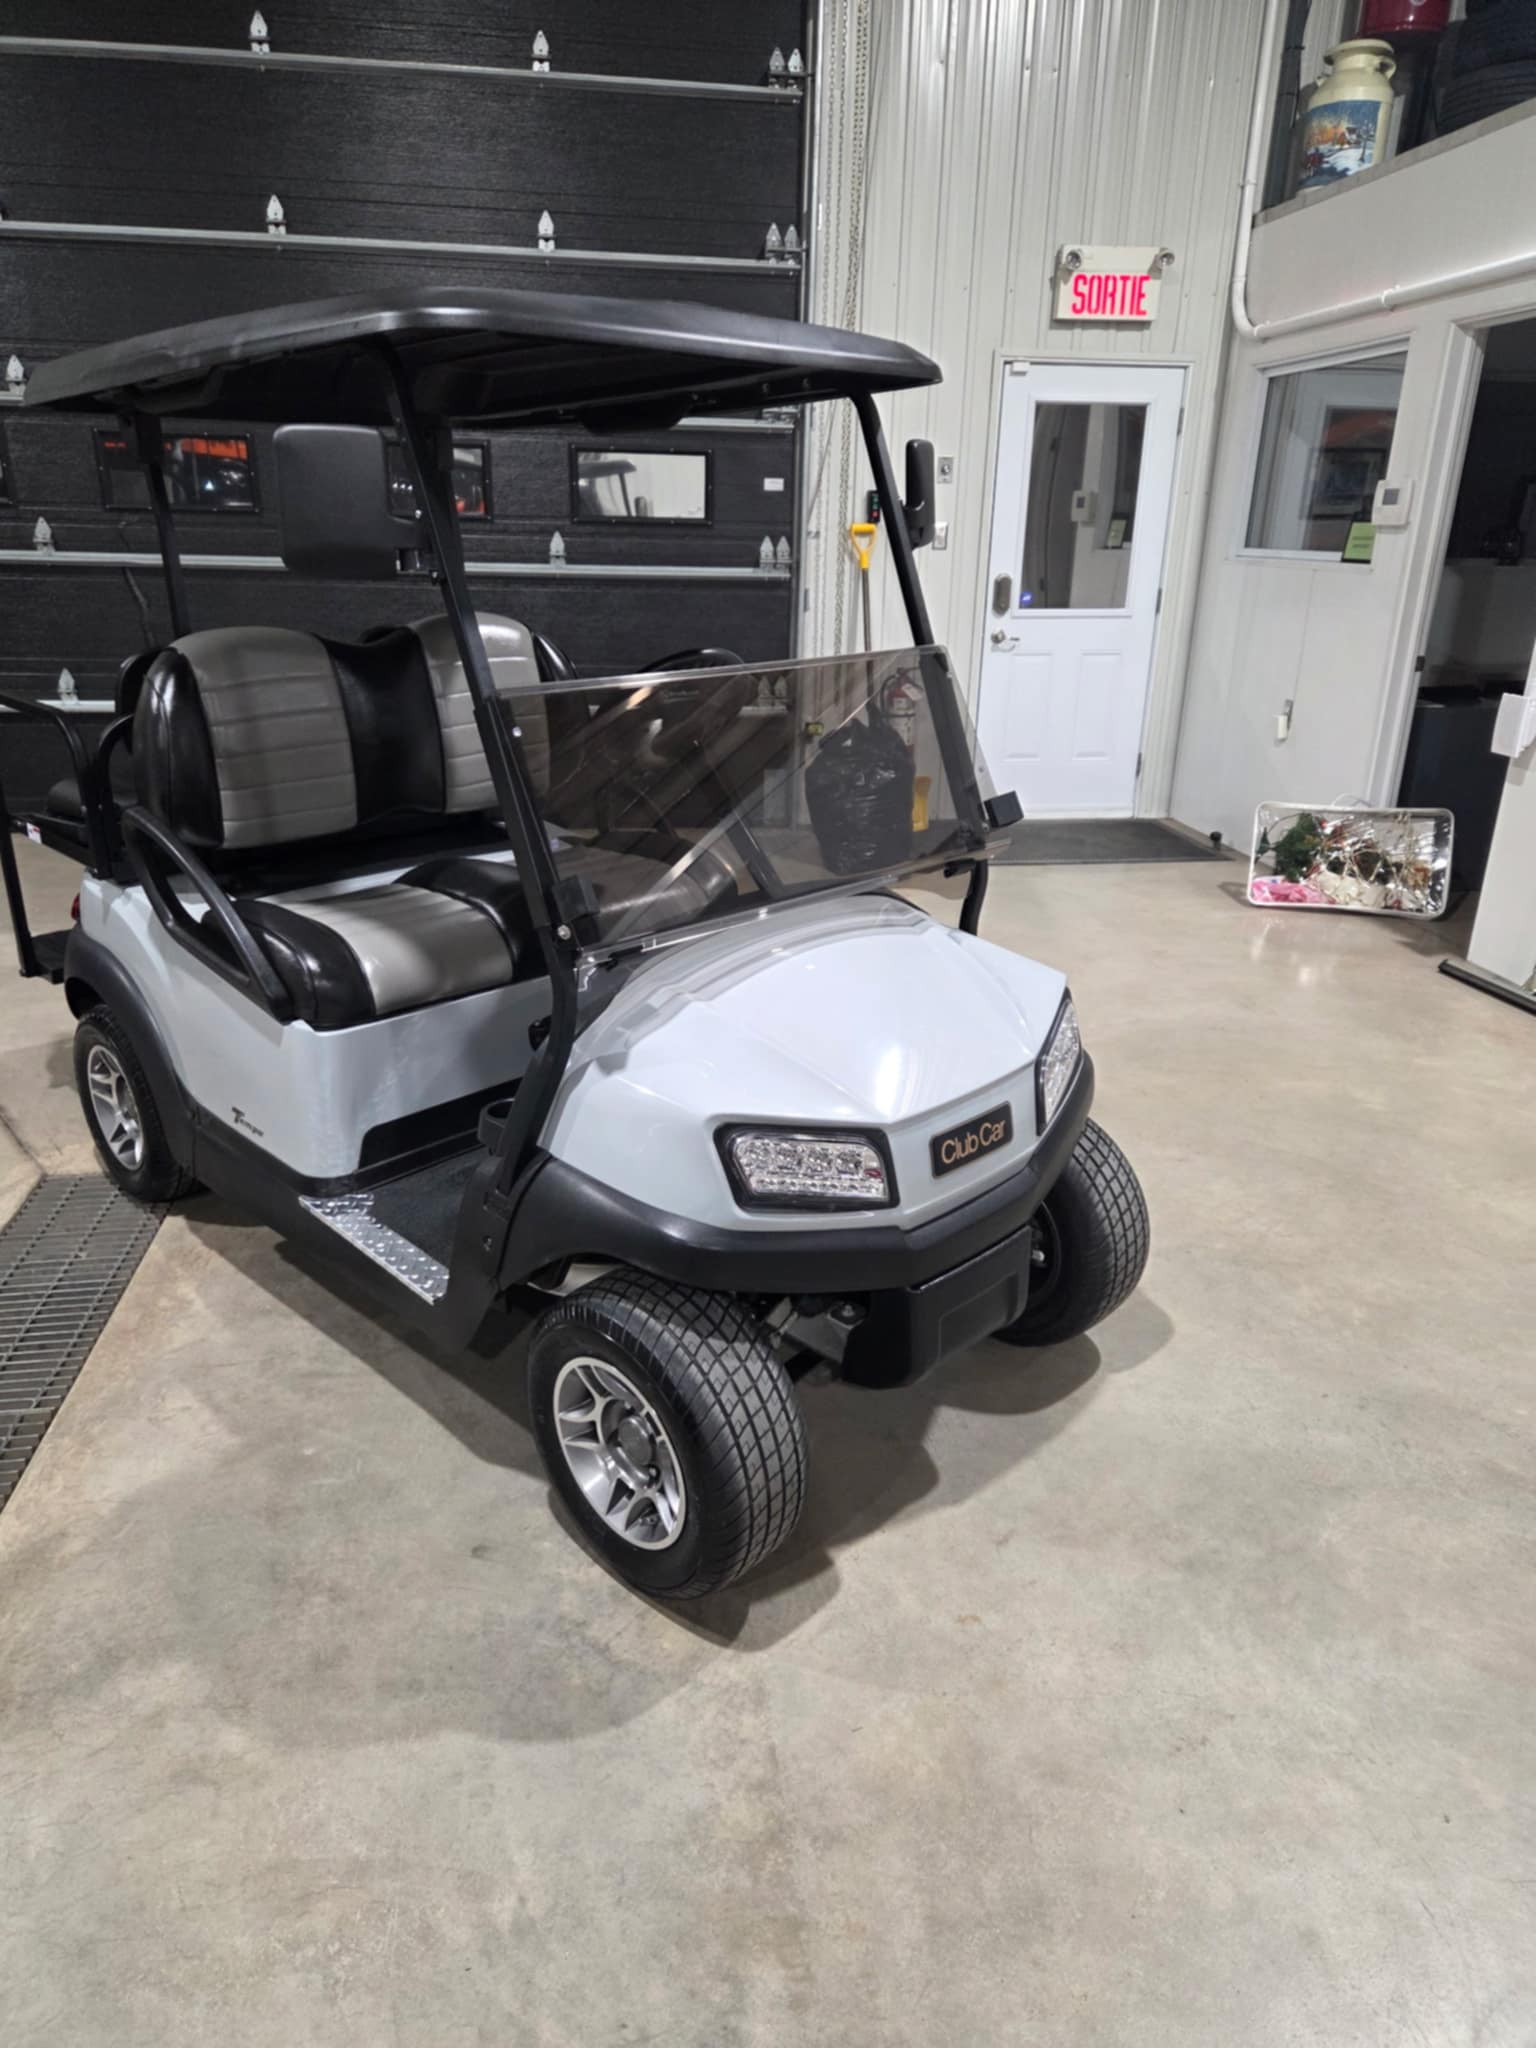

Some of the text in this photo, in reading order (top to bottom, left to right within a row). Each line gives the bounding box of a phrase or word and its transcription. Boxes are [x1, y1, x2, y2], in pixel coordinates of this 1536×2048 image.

[1071, 273, 1152, 316] SORTIE
[941, 1120, 1006, 1164] Club Car
